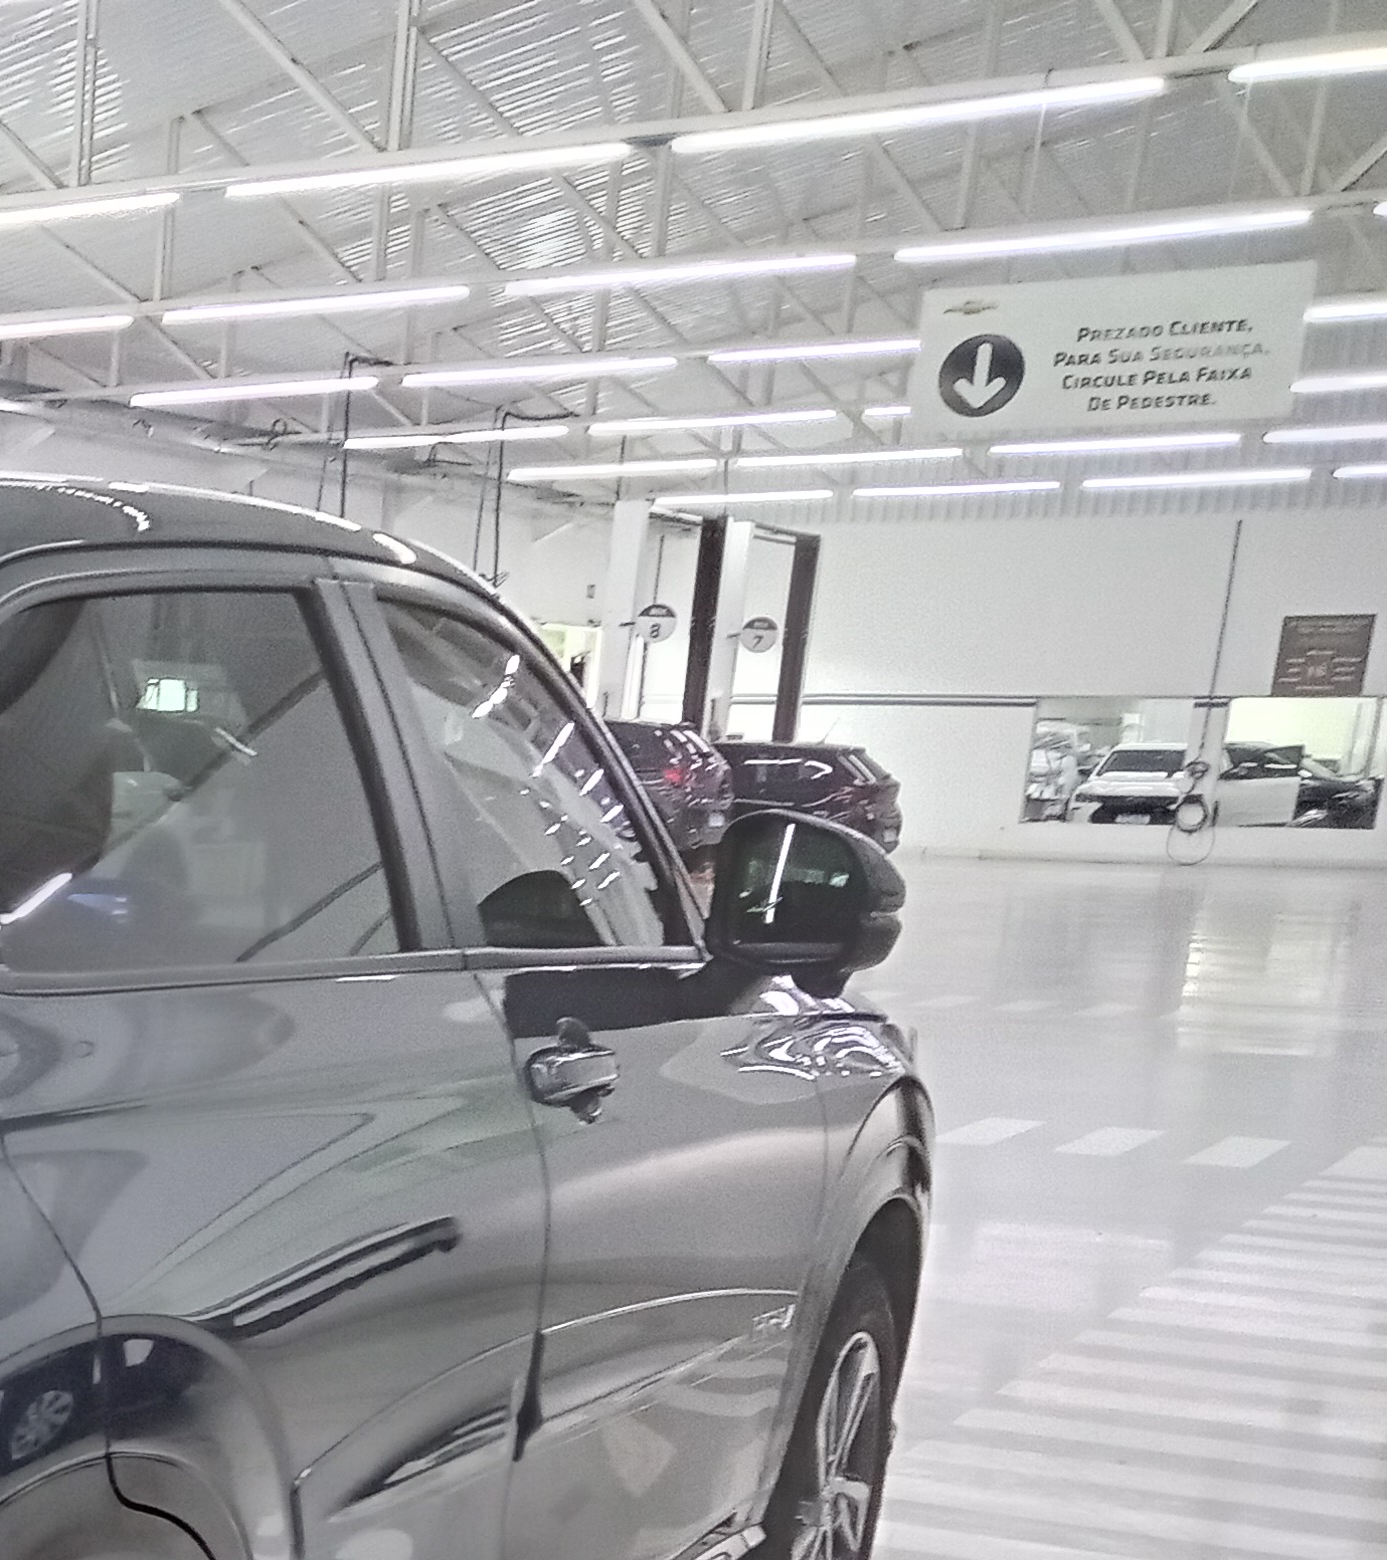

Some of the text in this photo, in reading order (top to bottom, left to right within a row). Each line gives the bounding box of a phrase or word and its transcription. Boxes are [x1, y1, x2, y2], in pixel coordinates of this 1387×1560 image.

[1053, 351, 1102, 367] PARA
[1108, 349, 1144, 364] SUA
[1142, 370, 1191, 386] PELA
[1196, 366, 1253, 383] FAIXA
[1087, 396, 1112, 412] DE
[649, 622, 661, 638] 8
[752, 635, 765, 649] 7
